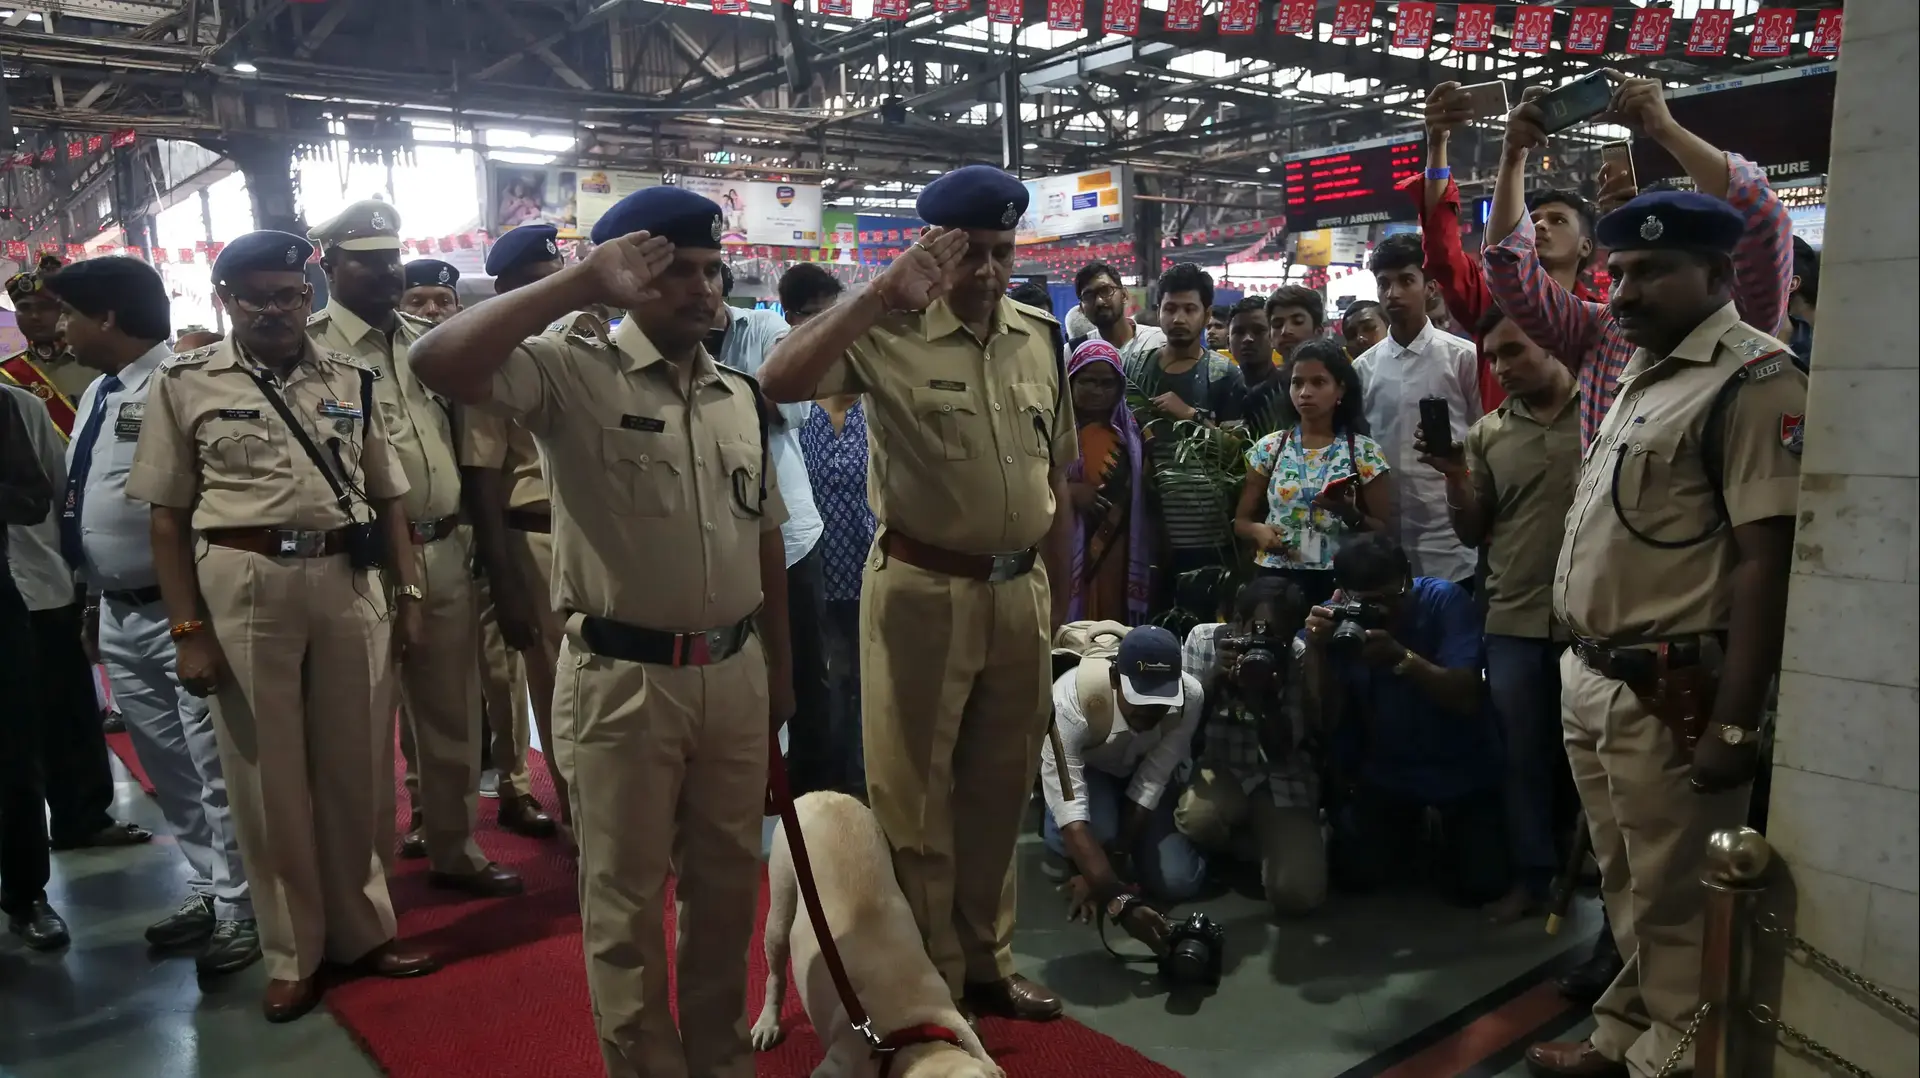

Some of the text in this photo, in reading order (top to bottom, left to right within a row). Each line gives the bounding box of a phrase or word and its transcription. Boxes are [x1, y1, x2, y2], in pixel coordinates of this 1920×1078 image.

[1050, 2, 1058, 27] RMU
[1245, 2, 1256, 31] AIRF
[1279, 4, 1290, 32] NRMU
[1304, 4, 1314, 32] AIRF
[1334, 6, 1346, 36] NRMU
[1358, 6, 1370, 36] AIRF
[1396, 10, 1408, 45] NRMU
[1421, 10, 1432, 46] AIRF
[1454, 12, 1466, 47] NRMU
[1480, 12, 1491, 48] AIRF
[1514, 14, 1526, 49] NRMU
[1540, 14, 1551, 49] AIRF
[1568, 14, 1582, 49] NRMU
[1594, 15, 1607, 50] AIRF
[1630, 15, 1645, 50] NRMU
[1656, 15, 1670, 51] AIRF
[1689, 16, 1704, 52] NRMU
[1715, 17, 1729, 52] AIRF
[1753, 17, 1765, 52] NRMU
[1780, 16, 1792, 52] AIRF
[1811, 17, 1827, 52] NRMU
[1350, 211, 1391, 225] ARRIVAL
